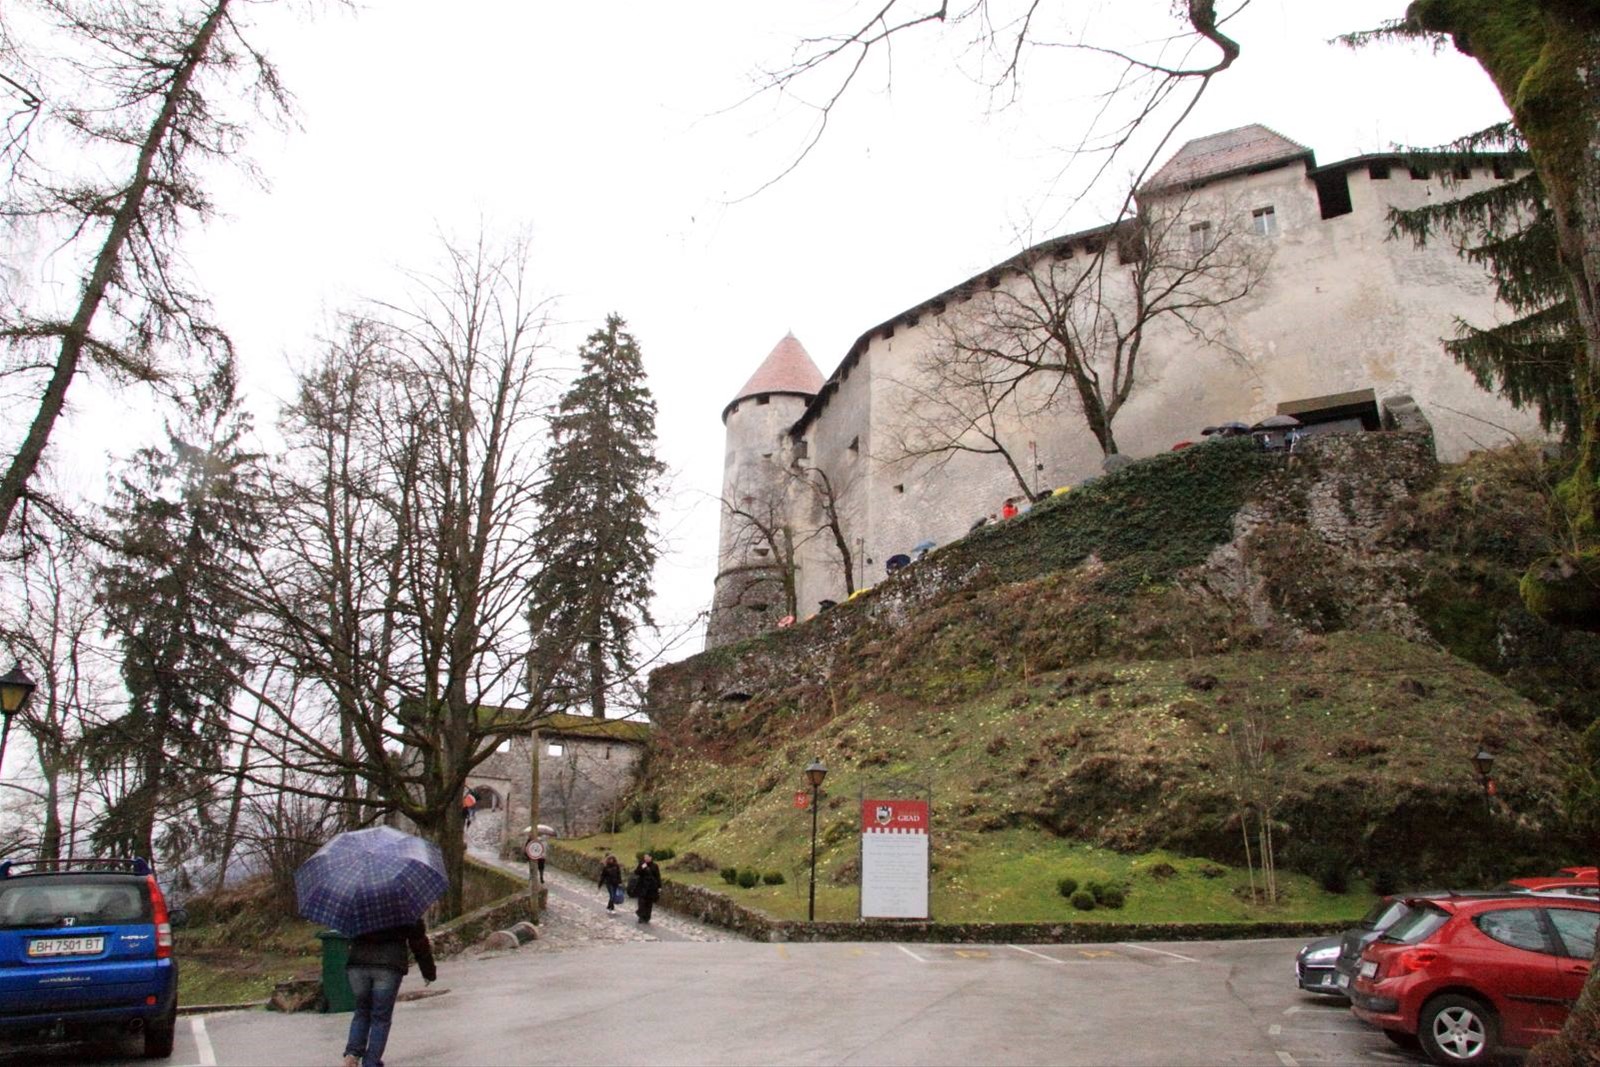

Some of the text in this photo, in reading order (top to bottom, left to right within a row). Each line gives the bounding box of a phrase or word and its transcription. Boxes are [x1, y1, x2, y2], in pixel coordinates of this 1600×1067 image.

[37, 938, 101, 952] BH 7501 BT
